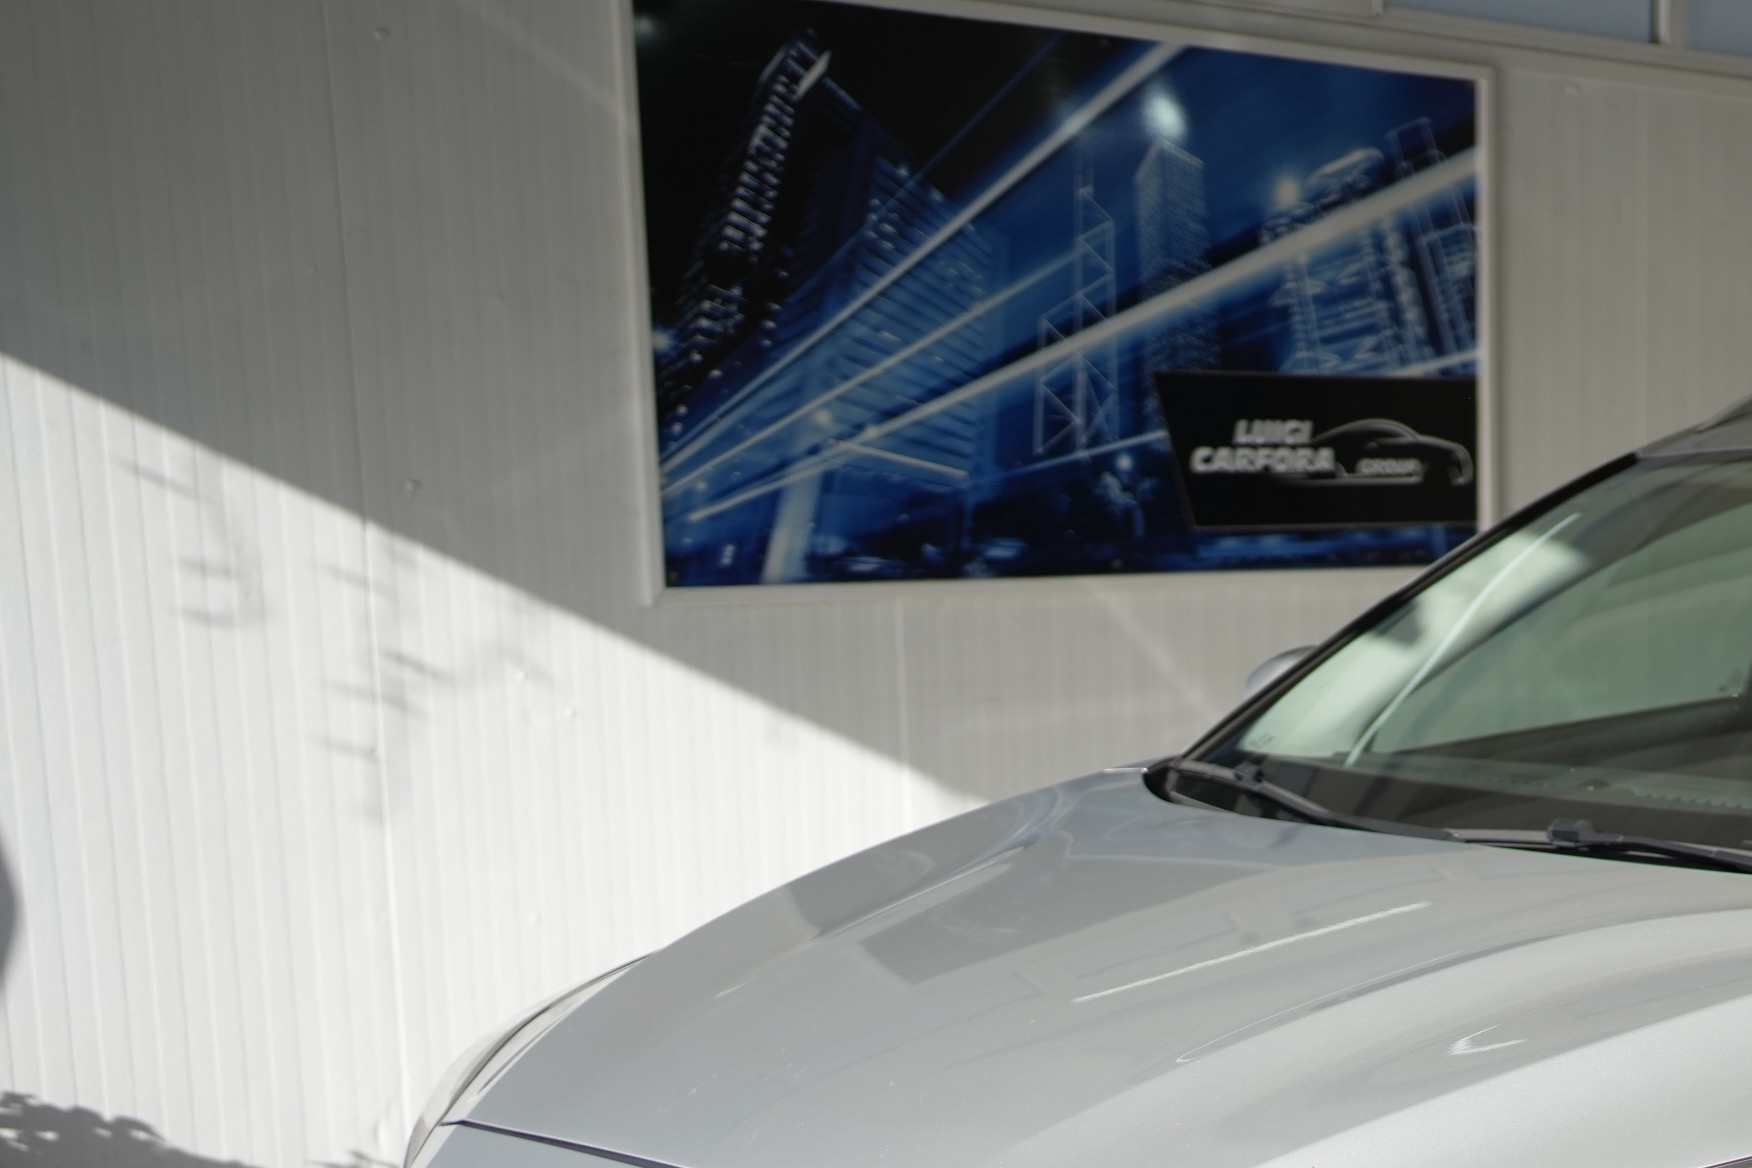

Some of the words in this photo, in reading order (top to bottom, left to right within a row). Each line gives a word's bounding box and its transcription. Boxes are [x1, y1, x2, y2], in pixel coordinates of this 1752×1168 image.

[1234, 419, 1314, 446] LUIGI
[1191, 447, 1337, 474] CARFORA
[1355, 458, 1422, 476] GROUP
